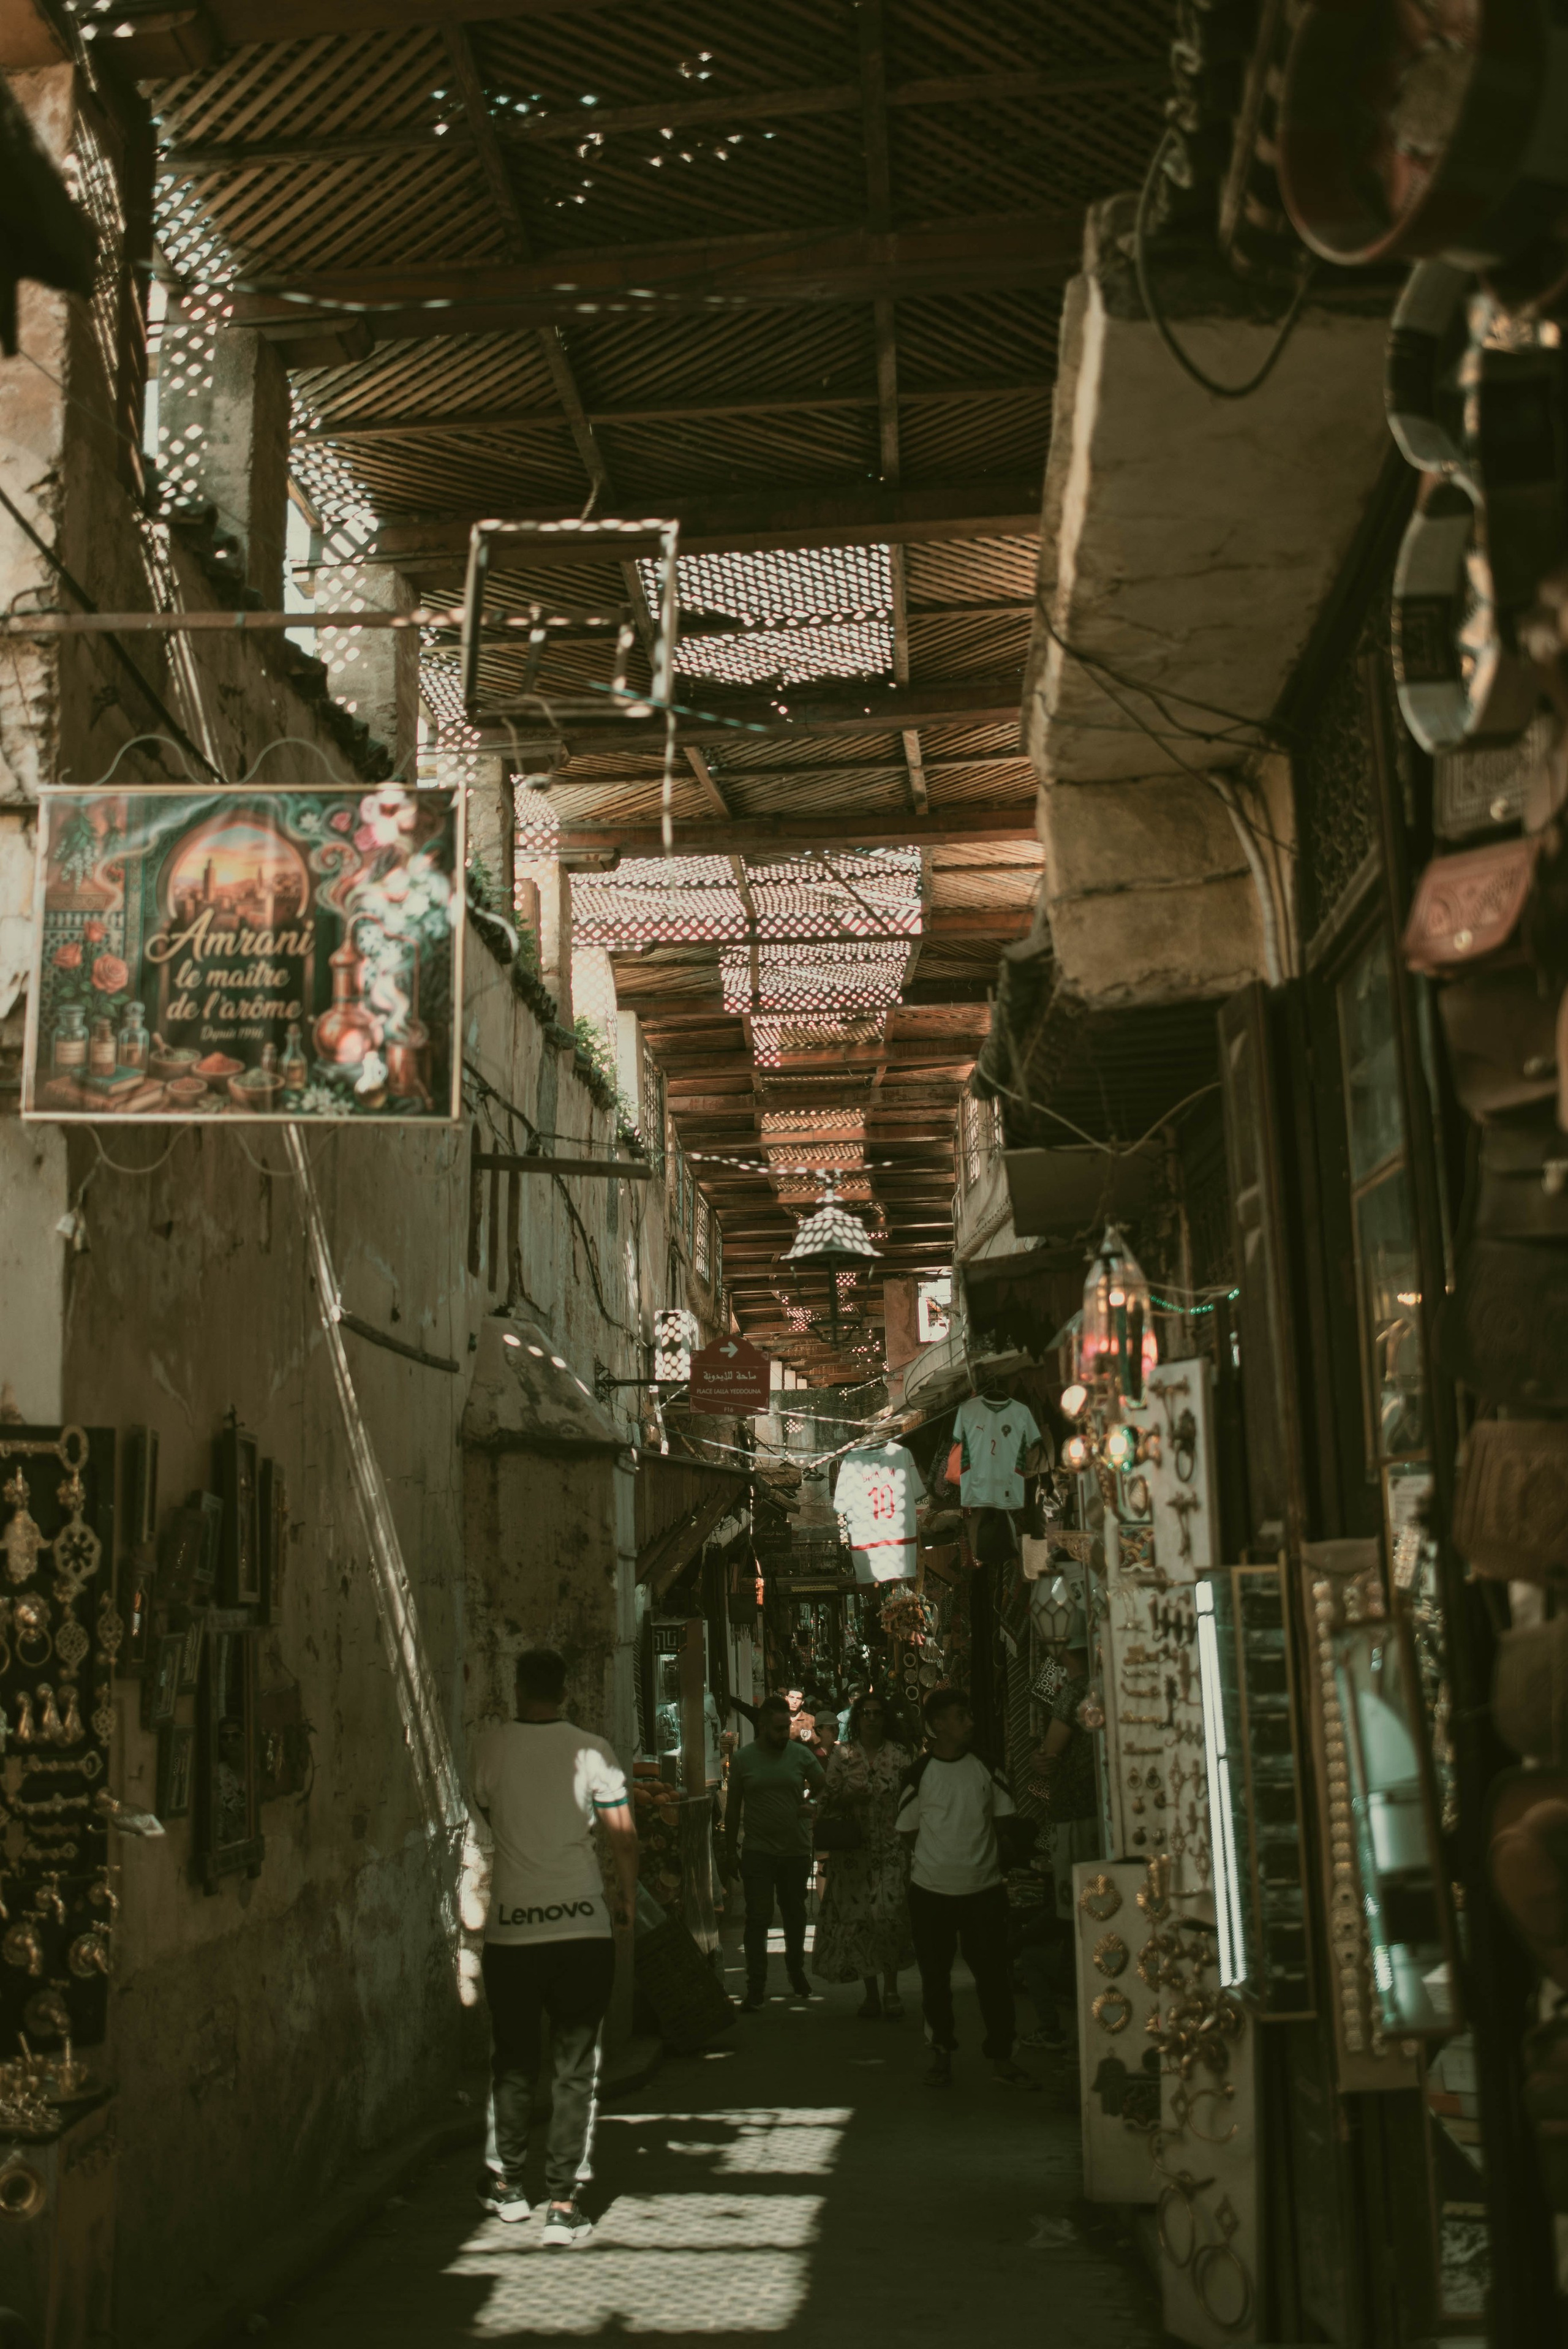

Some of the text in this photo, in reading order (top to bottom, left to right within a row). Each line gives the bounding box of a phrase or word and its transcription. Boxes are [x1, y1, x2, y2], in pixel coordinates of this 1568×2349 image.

[145, 908, 316, 963] Amrani
[175, 959, 291, 989] le maître
[165, 990, 303, 1020] de l'arôme
[736, 1371, 756, 1380] ساحة
[991, 1439, 996, 1455] 2
[868, 1484, 895, 1520] 10
[499, 1901, 594, 1926] Lenovo
